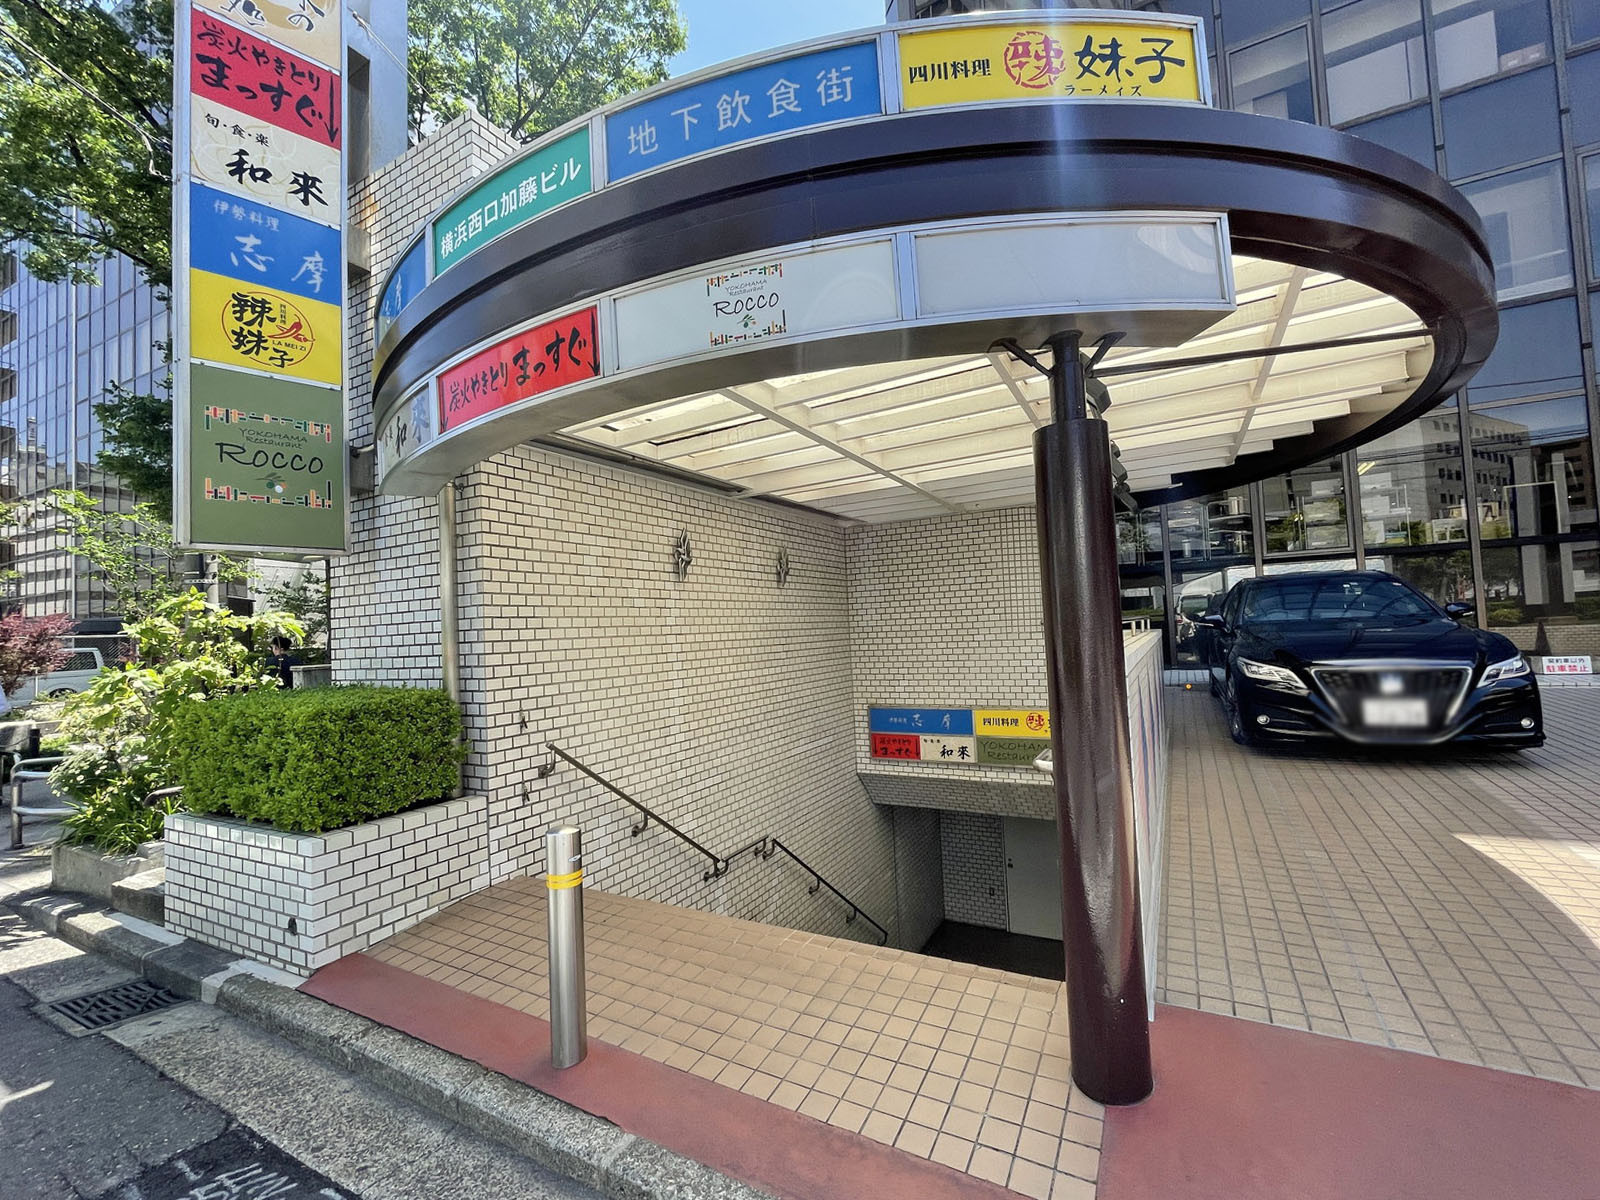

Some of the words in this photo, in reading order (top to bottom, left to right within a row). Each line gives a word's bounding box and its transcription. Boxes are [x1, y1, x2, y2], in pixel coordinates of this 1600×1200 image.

[197, 20, 320, 91] 炭火やきとり
[908, 58, 992, 84] 四川料理
[195, 53, 323, 128] まっすぐ
[627, 66, 854, 156] 地下飲食街
[213, 199, 280, 232] 伊勢料理
[440, 157, 582, 260] 横浜西口加藤ビル
[230, 233, 328, 294] 志摩
[725, 279, 768, 292] YOKOHAMA
[712, 292, 780, 318] ROCCO
[284, 342, 298, 350] MEI
[449, 361, 509, 412] 炭火やきとり
[512, 326, 587, 387] まっすぐ
[239, 428, 308, 443] YOKOHAMA
[245, 435, 303, 450] Restaurant
[214, 442, 324, 474] ROCCO
[983, 717, 1019, 727] 四川料理
